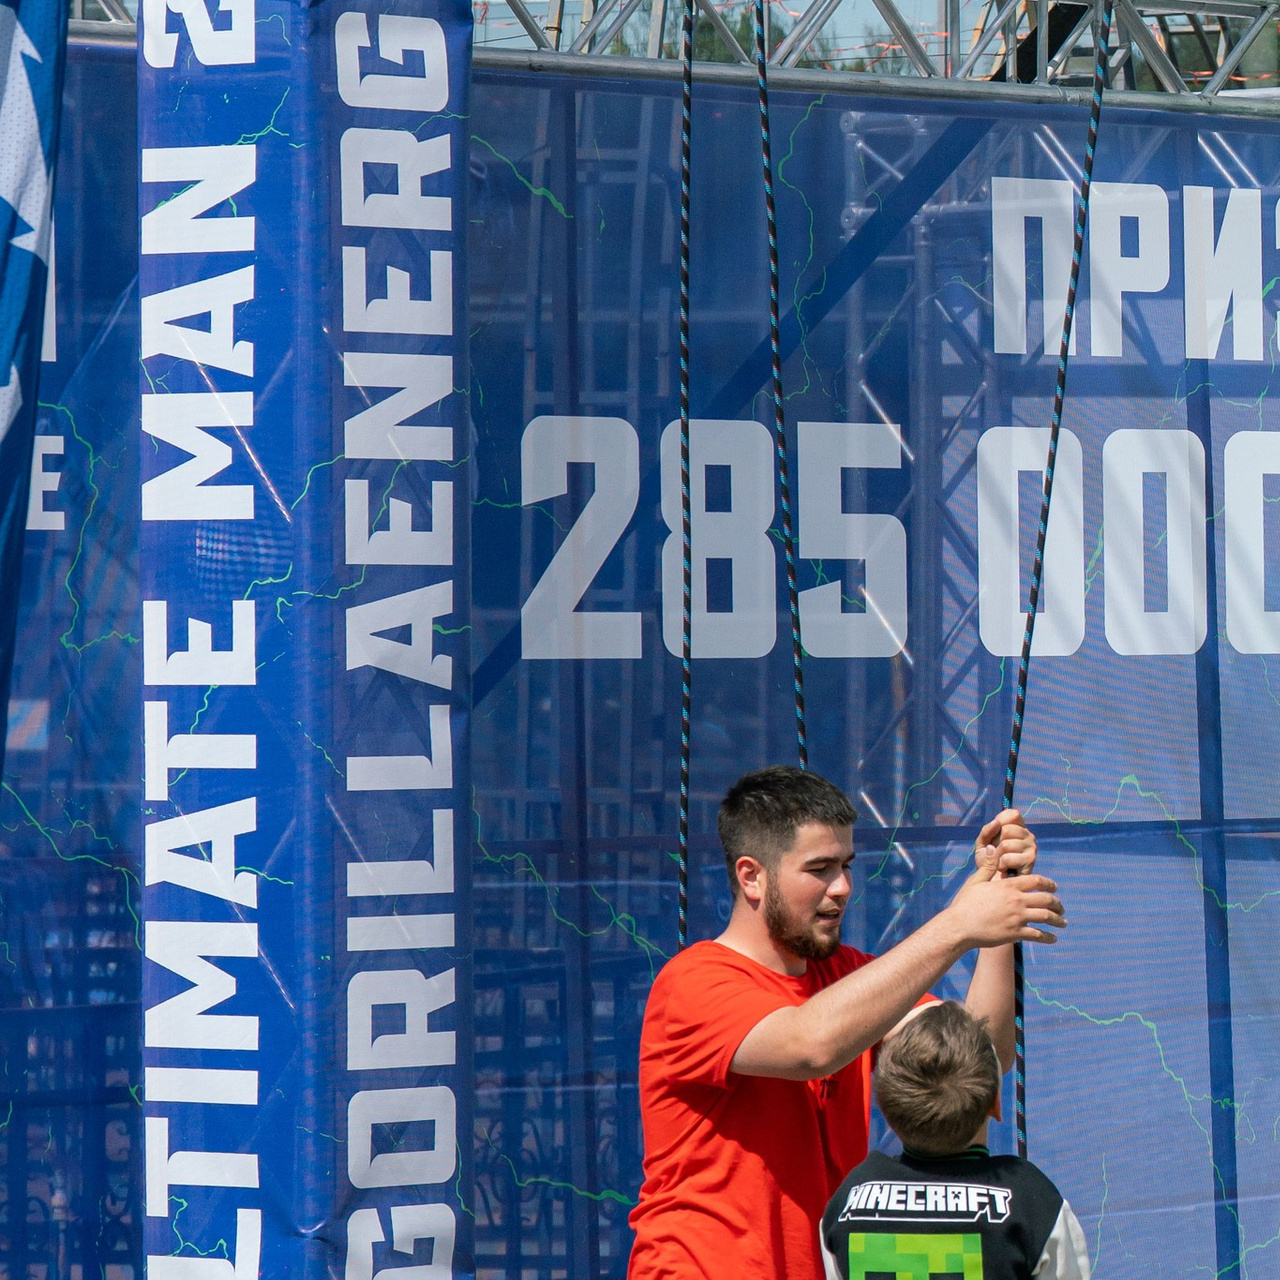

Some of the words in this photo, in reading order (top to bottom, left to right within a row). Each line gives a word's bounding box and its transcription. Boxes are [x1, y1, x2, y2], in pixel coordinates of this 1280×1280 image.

[140, 143, 257, 521] MAN
[520, 415, 908, 660] 285
[840, 1181, 1012, 1223] MINECRAFT
